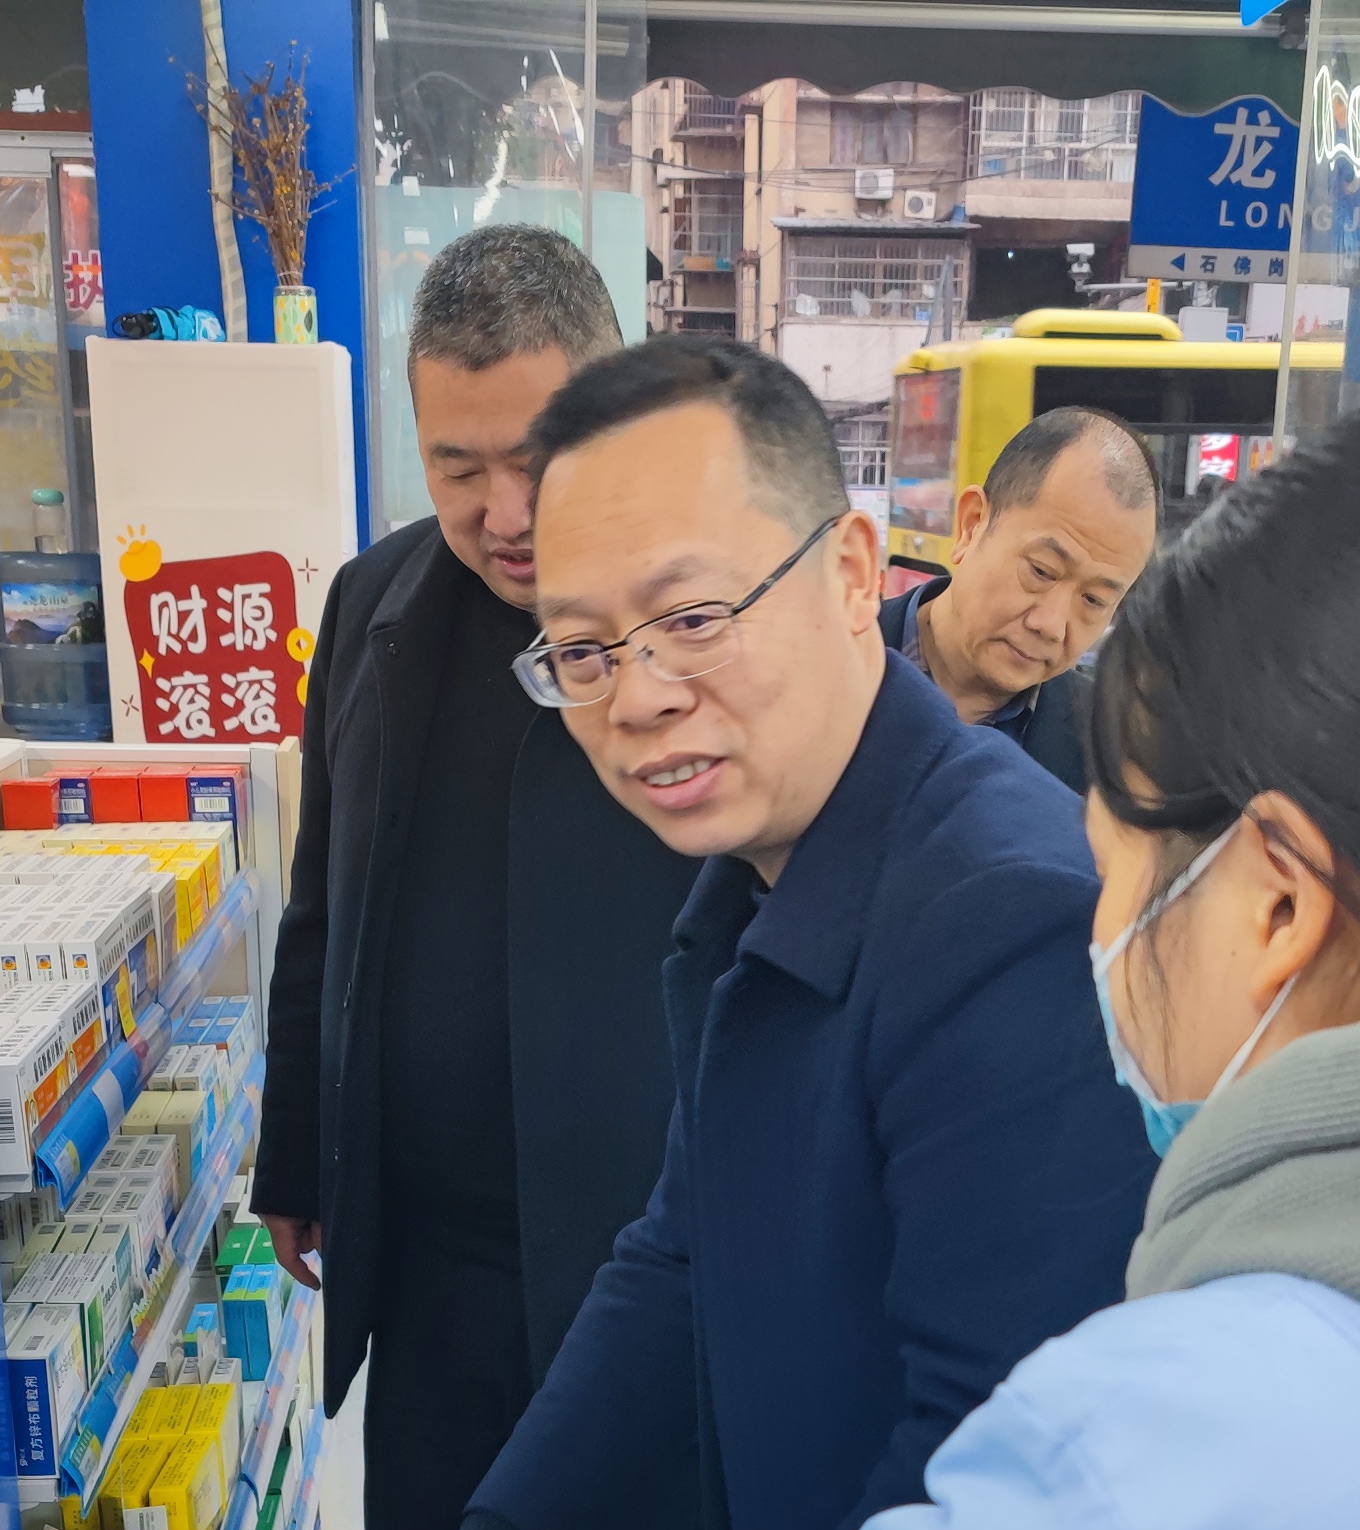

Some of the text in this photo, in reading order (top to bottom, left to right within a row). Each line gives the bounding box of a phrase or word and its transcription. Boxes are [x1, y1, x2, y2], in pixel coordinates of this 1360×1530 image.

[150, 582, 277, 656] 财源
[155, 667, 281, 739] 滚滚
[24, 1375, 44, 1461] 复方锌布颗粒剂
